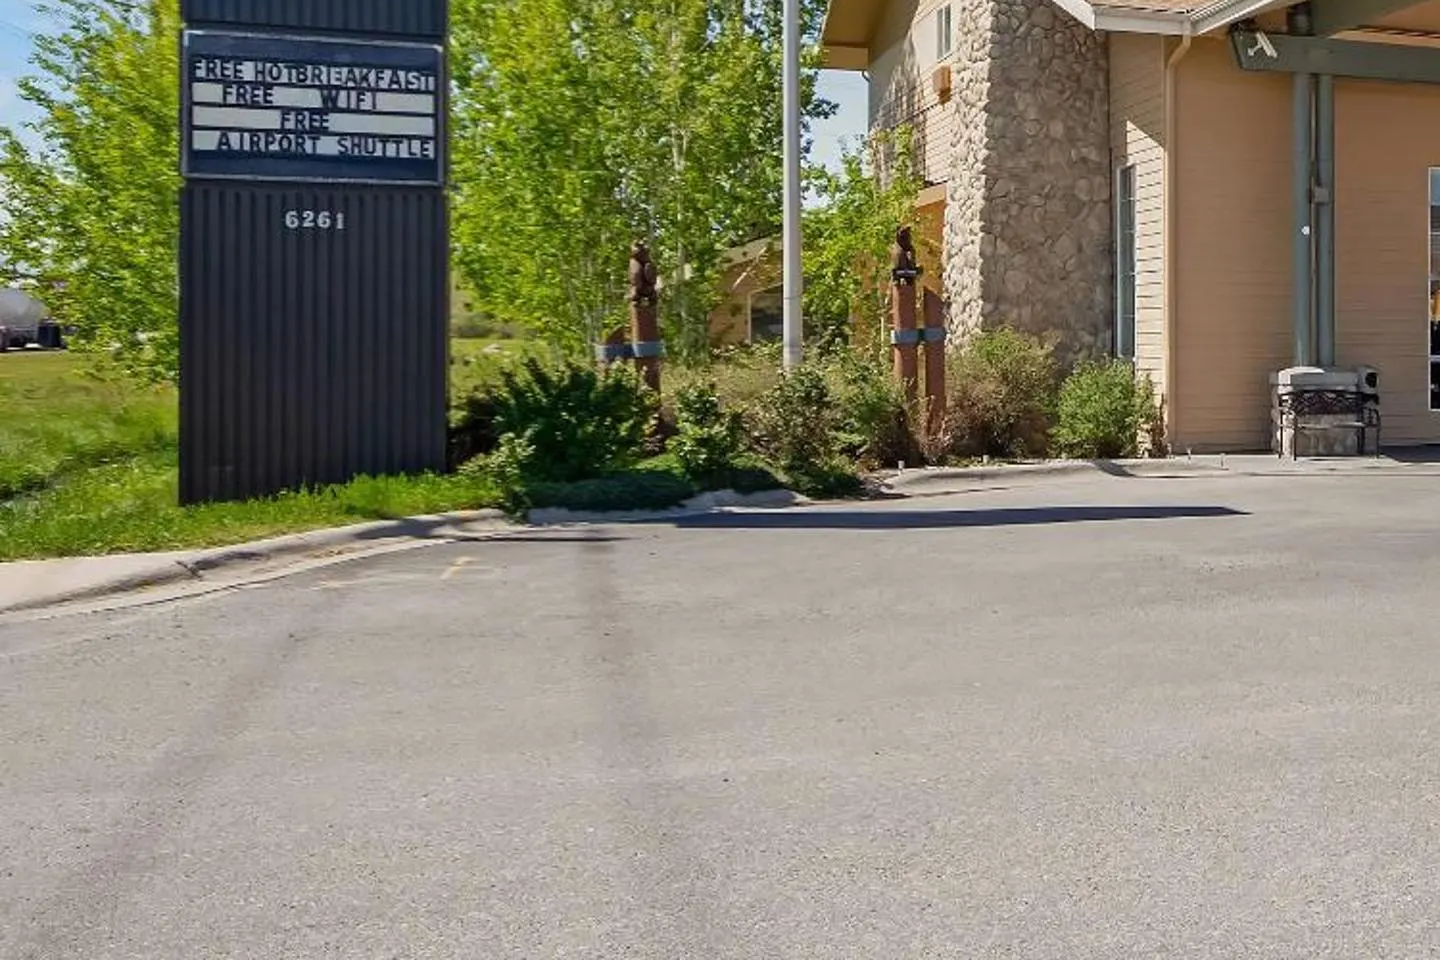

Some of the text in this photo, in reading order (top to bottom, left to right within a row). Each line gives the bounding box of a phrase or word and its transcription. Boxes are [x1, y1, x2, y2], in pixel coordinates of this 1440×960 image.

[192, 59, 245, 80] FREE
[222, 84, 378, 111] FREE WIFI
[280, 111, 330, 132] FREE
[216, 131, 432, 159] AIRPORT SHUTTLE
[285, 211, 345, 230] 6261
